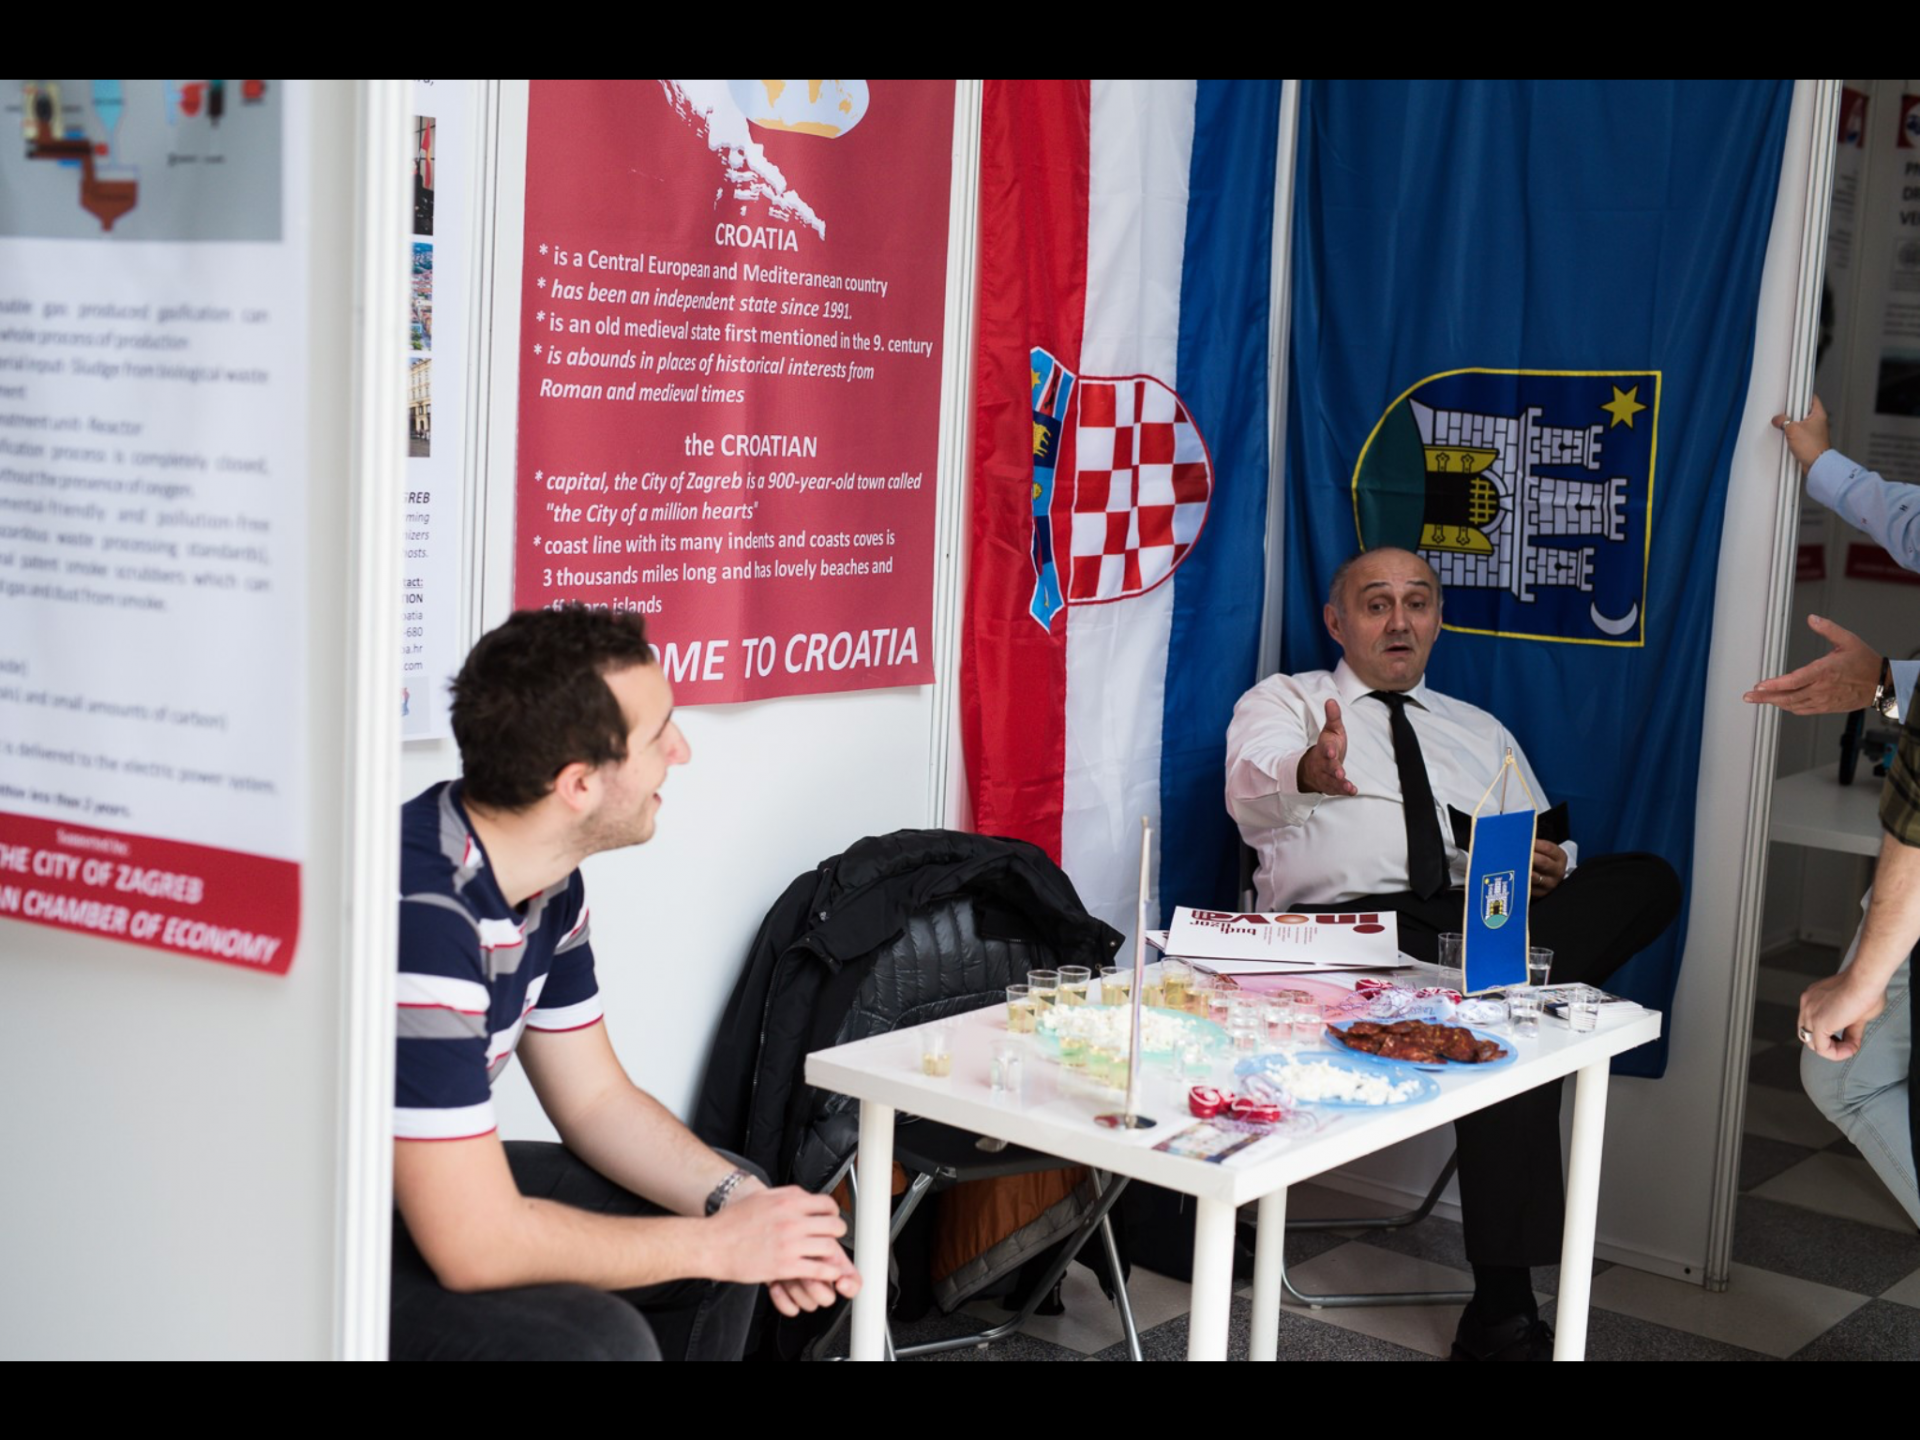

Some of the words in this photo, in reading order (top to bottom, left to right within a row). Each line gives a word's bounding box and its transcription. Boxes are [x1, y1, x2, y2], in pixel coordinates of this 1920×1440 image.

[715, 222, 798, 252] CROATIA
[554, 246, 568, 266] is
[573, 252, 582, 267] a
[588, 250, 644, 272] Central
[648, 256, 710, 280] European
[712, 262, 737, 280] and
[743, 264, 842, 289] Mediteranean
[845, 278, 888, 298] country
[551, 278, 584, 300] has
[588, 282, 626, 303] been
[630, 290, 650, 305] an
[654, 288, 736, 312] independent
[739, 296, 777, 313] state
[780, 298, 819, 317] since
[822, 301, 852, 319] 1991.
[550, 312, 564, 332] is
[569, 319, 590, 334] an
[596, 316, 620, 336] old
[624, 319, 688, 339] medieval
[691, 324, 720, 341] state
[725, 323, 757, 342] first
[760, 328, 838, 348] mentioned
[840, 332, 850, 348] in
[852, 332, 870, 350] the
[873, 334, 884, 351] 9.
[888, 338, 933, 358] century
[547, 345, 562, 364] is
[567, 347, 636, 368] abounds
[640, 350, 654, 369] in
[656, 352, 696, 374] places
[699, 353, 714, 376] of
[716, 354, 785, 374] historical
[788, 358, 846, 378] interests
[847, 361, 874, 382] from
[540, 378, 602, 399] Roman
[606, 382, 636, 400] and
[638, 383, 699, 402] medieval
[702, 384, 745, 403] times
[684, 432, 714, 456] the
[721, 434, 817, 457] CROATIAN
[546, 472, 608, 494] capital,
[614, 472, 638, 490] the
[641, 472, 668, 494] City
[670, 471, 685, 494] of
[686, 471, 742, 493] Zagreb
[746, 472, 756, 489] is
[758, 476, 765, 489] a
[768, 472, 855, 493] 900-year-old
[858, 475, 885, 490] town
[888, 472, 922, 489] called
[547, 503, 582, 522] "the
[586, 504, 618, 526] City
[621, 503, 638, 526] of
[638, 508, 648, 521] a
[650, 502, 698, 520] million
[545, 538, 588, 554] coast
[593, 535, 622, 554] line
[626, 534, 656, 553] with
[661, 534, 676, 551] its
[680, 537, 723, 554] many
[728, 531, 774, 549] indents
[778, 530, 806, 548] and
[810, 532, 850, 547] coasts
[853, 533, 884, 546] coves
[886, 529, 895, 545] is
[543, 568, 552, 586] 3
[556, 565, 638, 586] thousands
[642, 564, 678, 582] miles
[683, 563, 717, 584] long
[722, 561, 751, 579] and
[754, 561, 771, 578] has
[775, 559, 817, 580] lovely
[820, 558, 869, 576] beaches
[872, 556, 892, 574] and
[613, 595, 662, 615] islands
[742, 636, 776, 678] TO
[785, 627, 918, 673] CROATIA
[32, 849, 81, 881] CITY
[82, 858, 113, 888] OF
[115, 864, 204, 904] ZAGREB
[23, 889, 129, 934] CHAMBER
[130, 910, 164, 941] OF
[162, 916, 282, 964] ECONOMY
